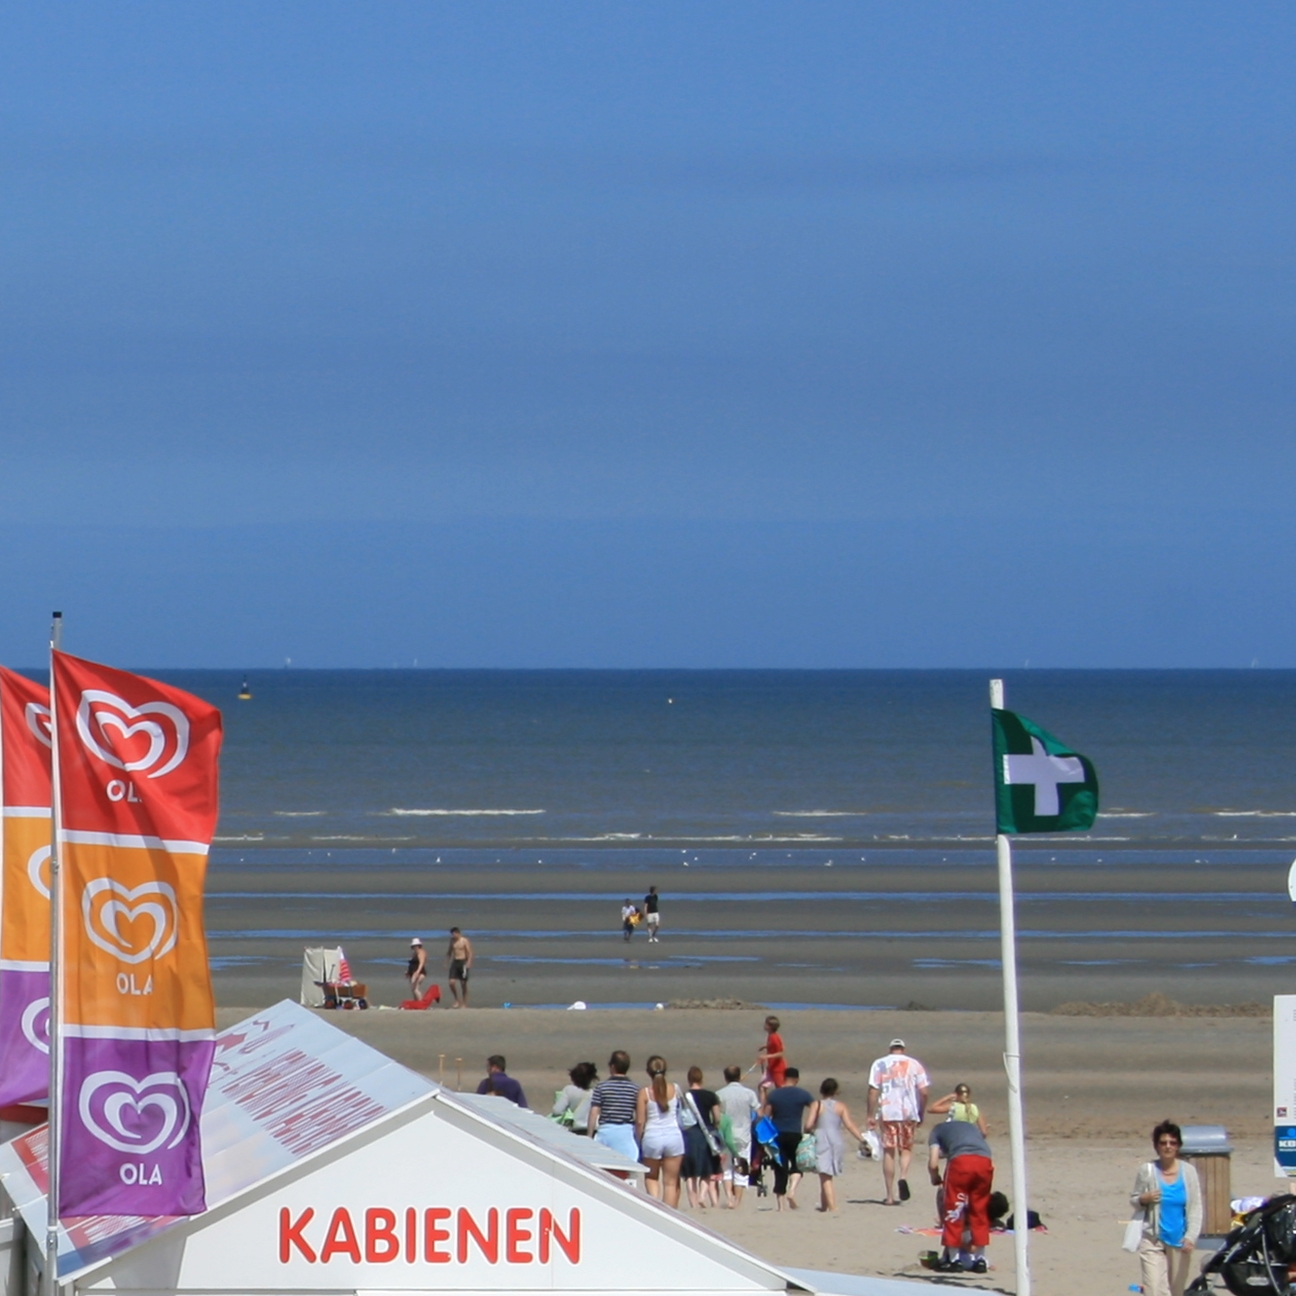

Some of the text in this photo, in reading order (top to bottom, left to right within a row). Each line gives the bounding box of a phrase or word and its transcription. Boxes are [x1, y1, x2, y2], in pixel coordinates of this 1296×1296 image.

[106, 779, 143, 803] OL
[116, 972, 153, 995] OLA
[119, 1162, 162, 1185] OLA
[279, 1207, 581, 1265] KABIENEN
